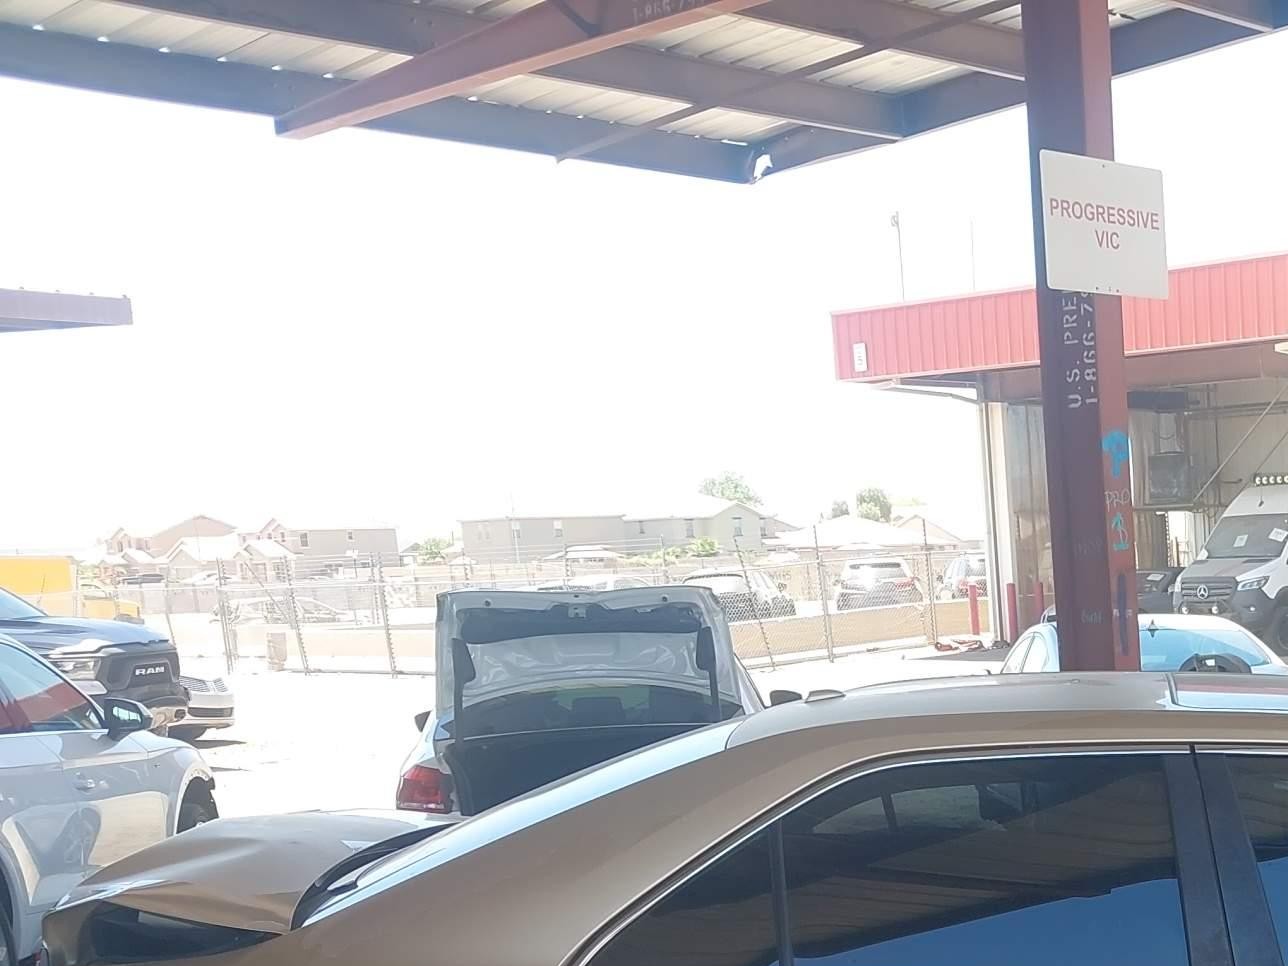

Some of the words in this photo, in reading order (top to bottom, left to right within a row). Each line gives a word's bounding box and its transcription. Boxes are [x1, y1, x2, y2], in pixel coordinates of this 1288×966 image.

[1049, 198, 1160, 231] PROGRESSIVE
[1095, 230, 1121, 250] VIC
[1062, 290, 1079, 345] PRE
[1065, 360, 1081, 409] U.S.
[135, 666, 165, 676] RAM
